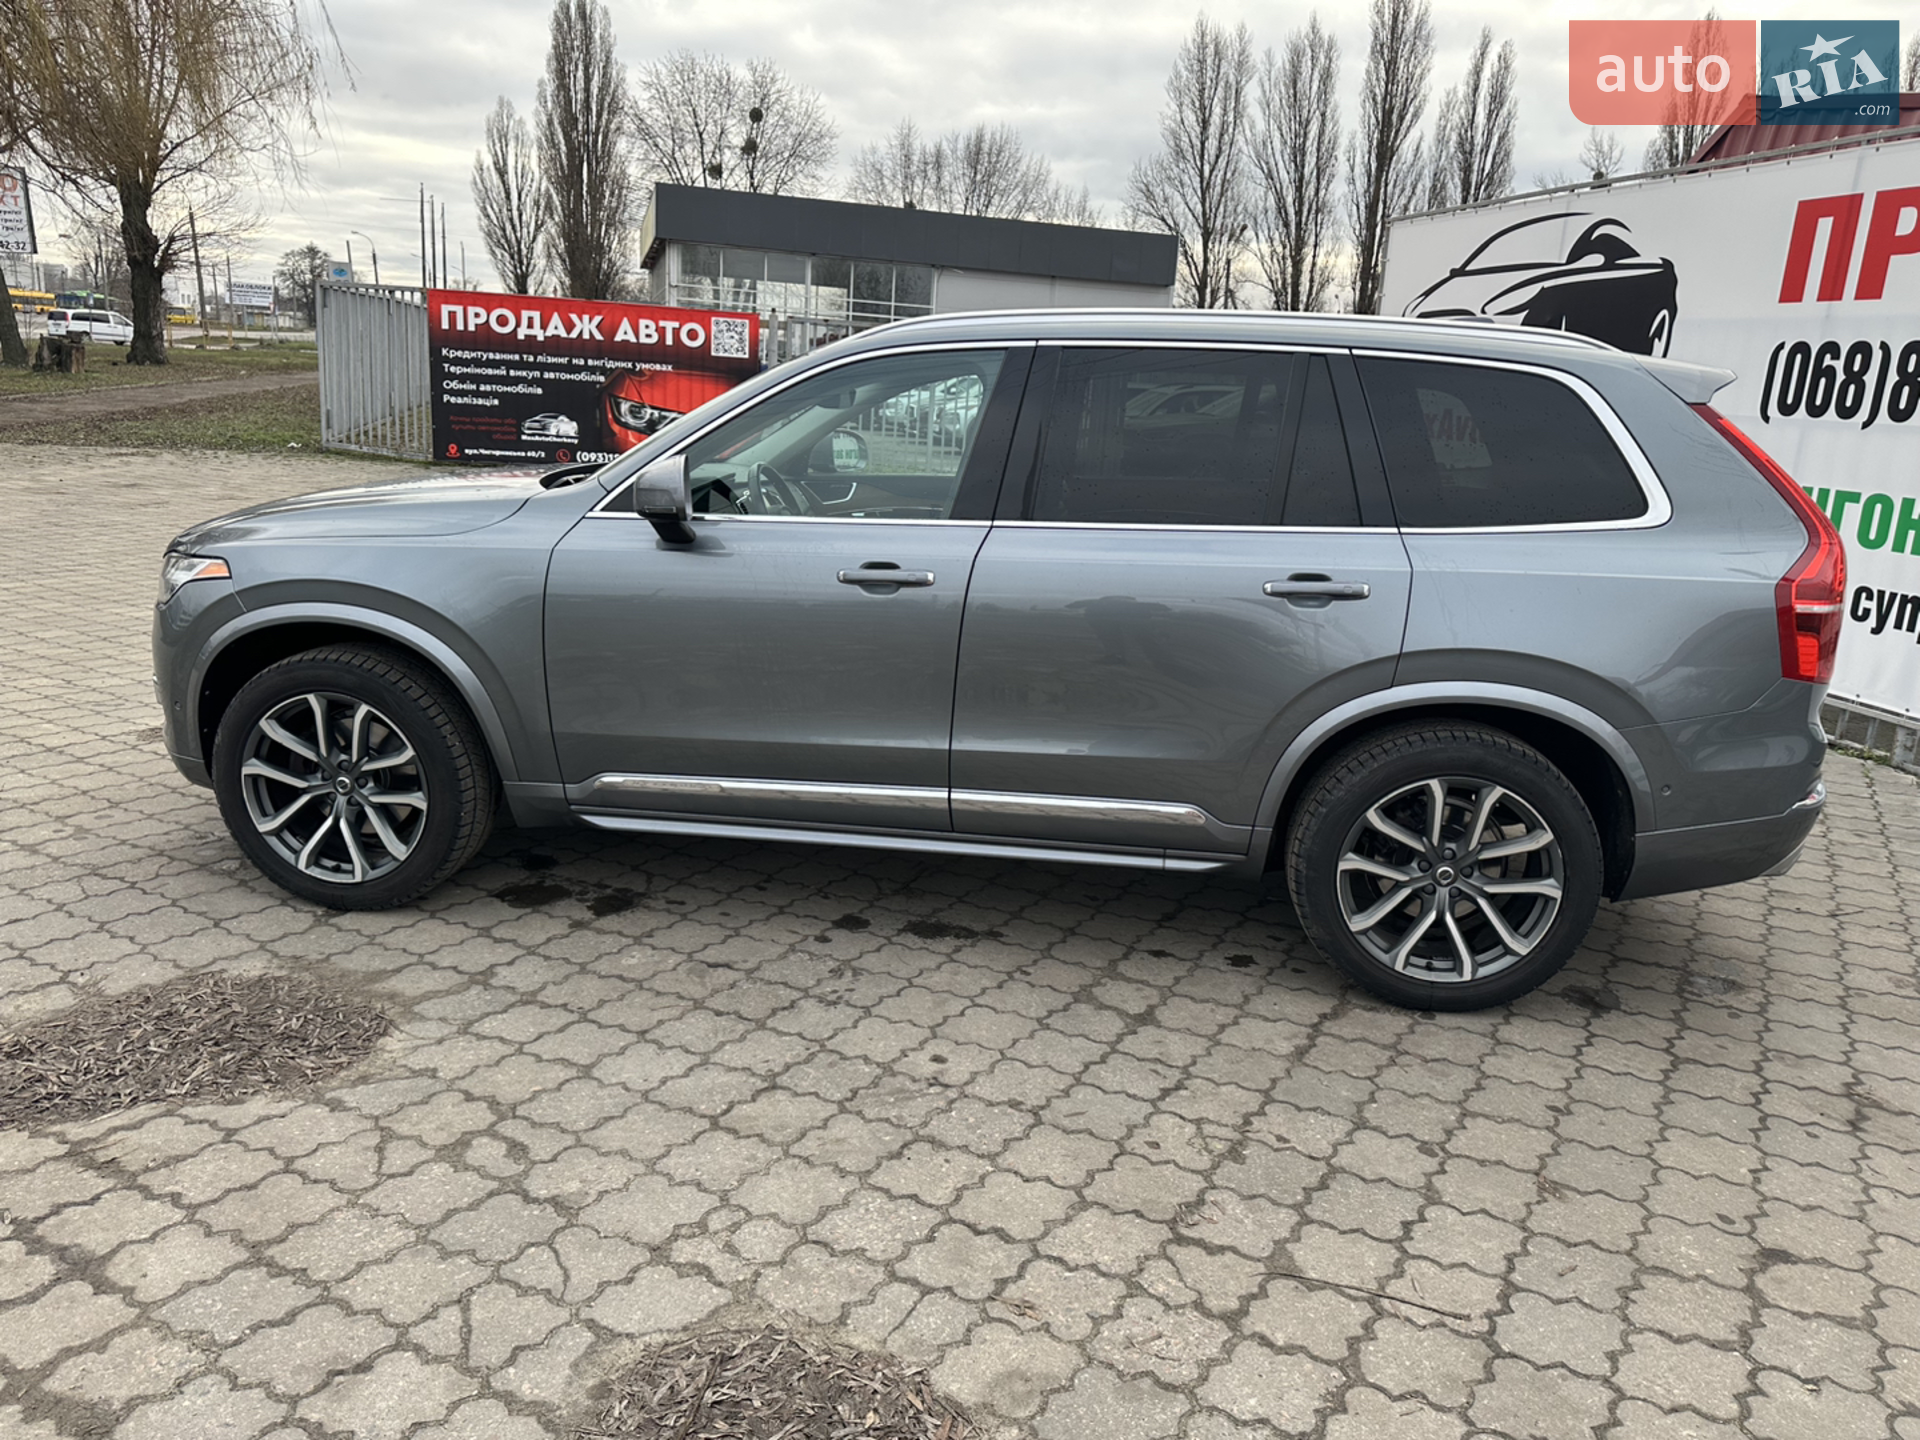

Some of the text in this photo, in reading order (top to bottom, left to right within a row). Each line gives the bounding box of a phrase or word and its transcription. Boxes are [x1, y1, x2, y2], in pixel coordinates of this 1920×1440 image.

[1778, 187, 1920, 303] ПР
[440, 304, 706, 348] ПРОДАЖ АВТО
[441, 347, 674, 371] Кредитування та лізинг на вигідних умовах
[442, 363, 606, 382] Терміновий викуп автомобілів
[442, 379, 544, 395] Обмін автомобілів
[443, 394, 500, 407] Реалізація
